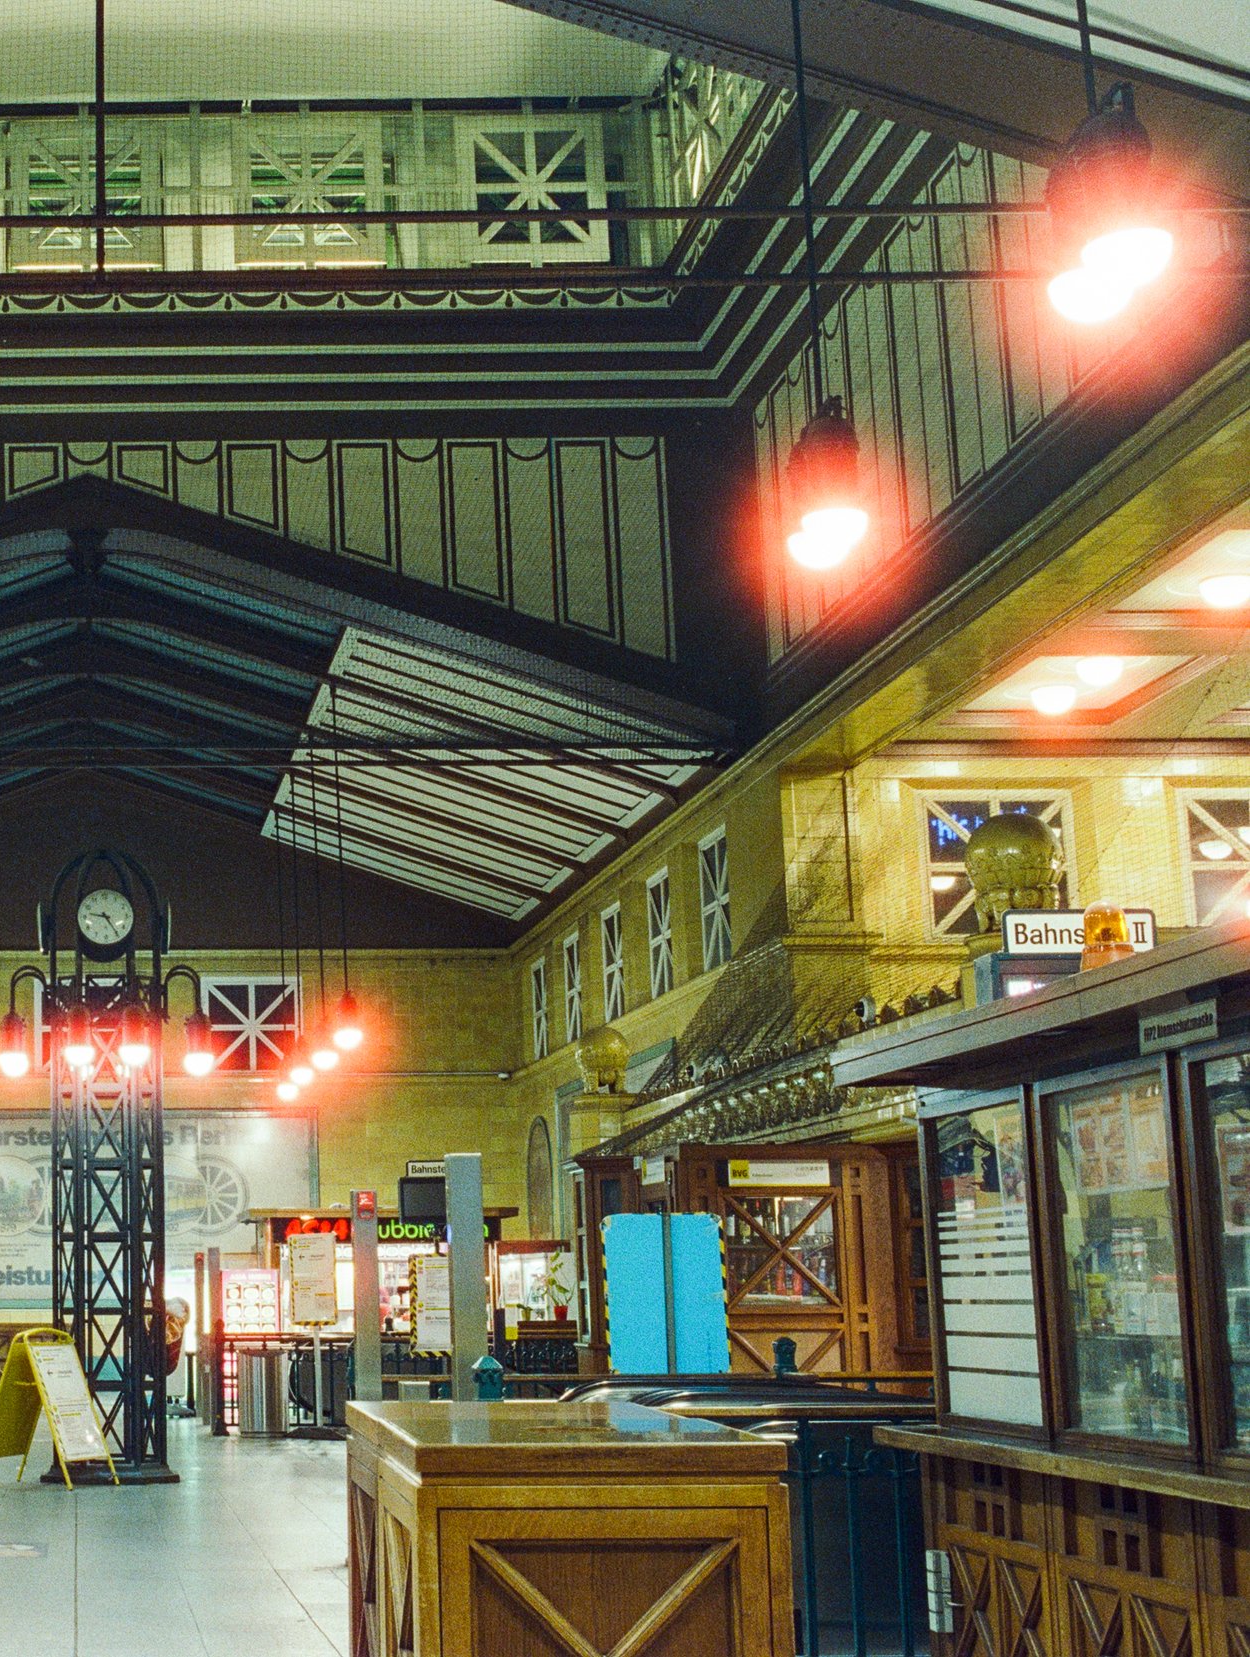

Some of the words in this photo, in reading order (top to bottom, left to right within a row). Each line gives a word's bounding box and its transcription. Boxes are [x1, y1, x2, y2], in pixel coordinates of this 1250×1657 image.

[1014, 923, 1085, 945] Bahns
[411, 1164, 446, 1174] Bahnste
[732, 1169, 748, 1178] BVG
